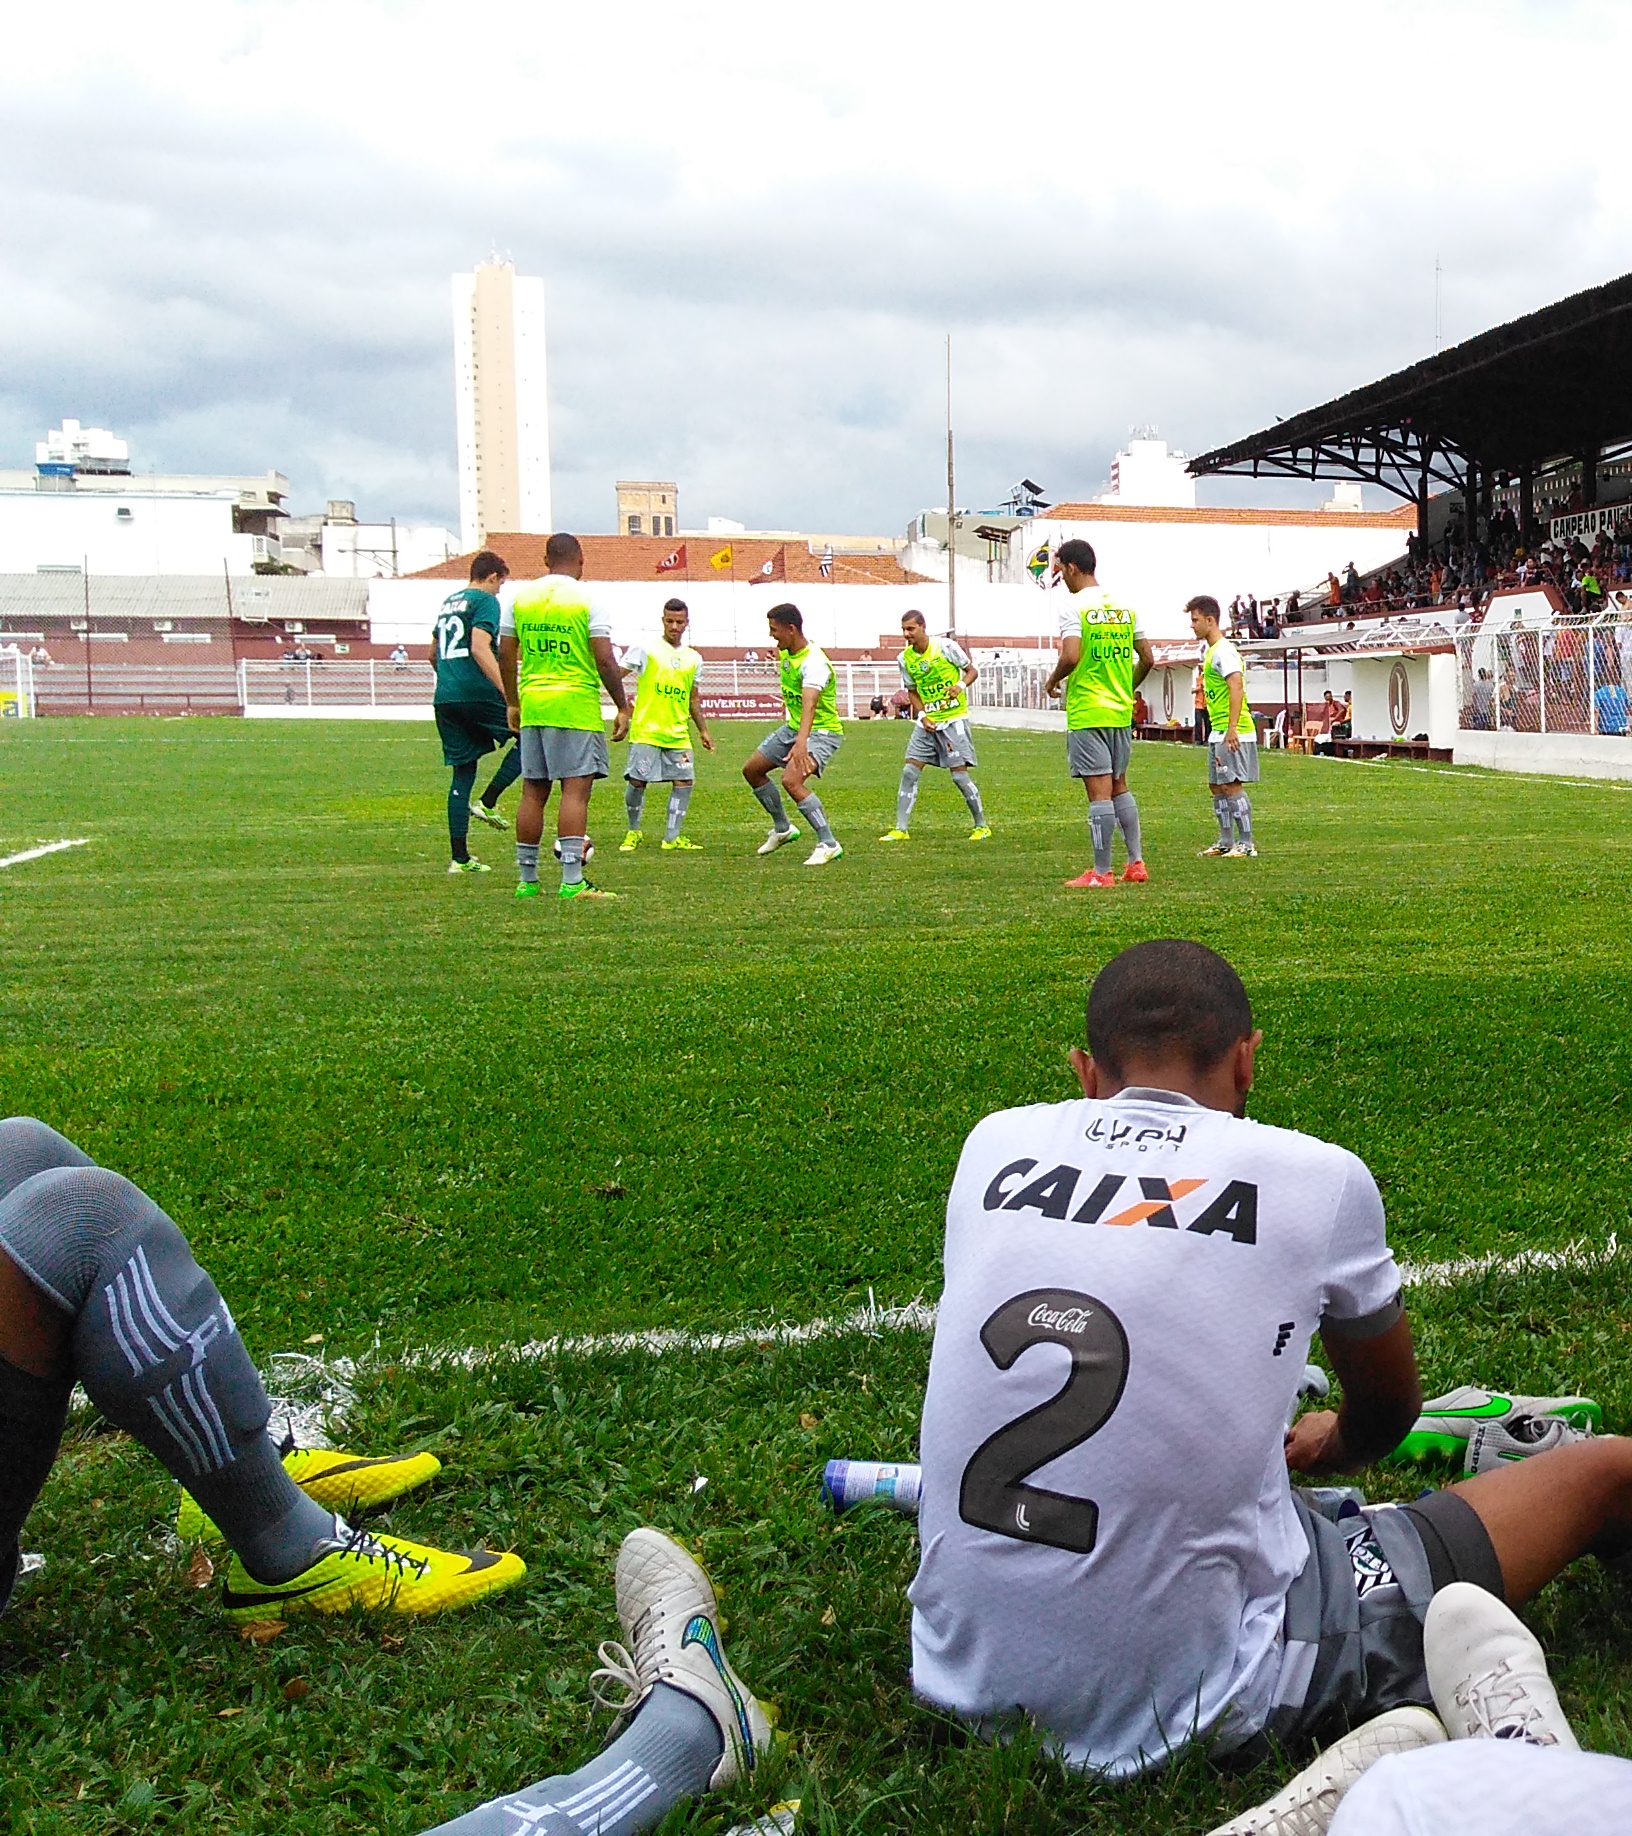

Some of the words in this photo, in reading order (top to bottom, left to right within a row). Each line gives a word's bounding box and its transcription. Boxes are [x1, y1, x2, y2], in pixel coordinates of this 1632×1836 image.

[1086, 609, 1132, 625] CAIXA
[437, 615, 469, 660] 12
[527, 638, 570, 656] LUPO
[1092, 646, 1130, 661] LUPO
[655, 682, 687, 700] LUPO
[700, 699, 757, 708] JUVENTUS
[983, 1158, 1258, 1245] CAIXA
[959, 1287, 1130, 1554] 2
